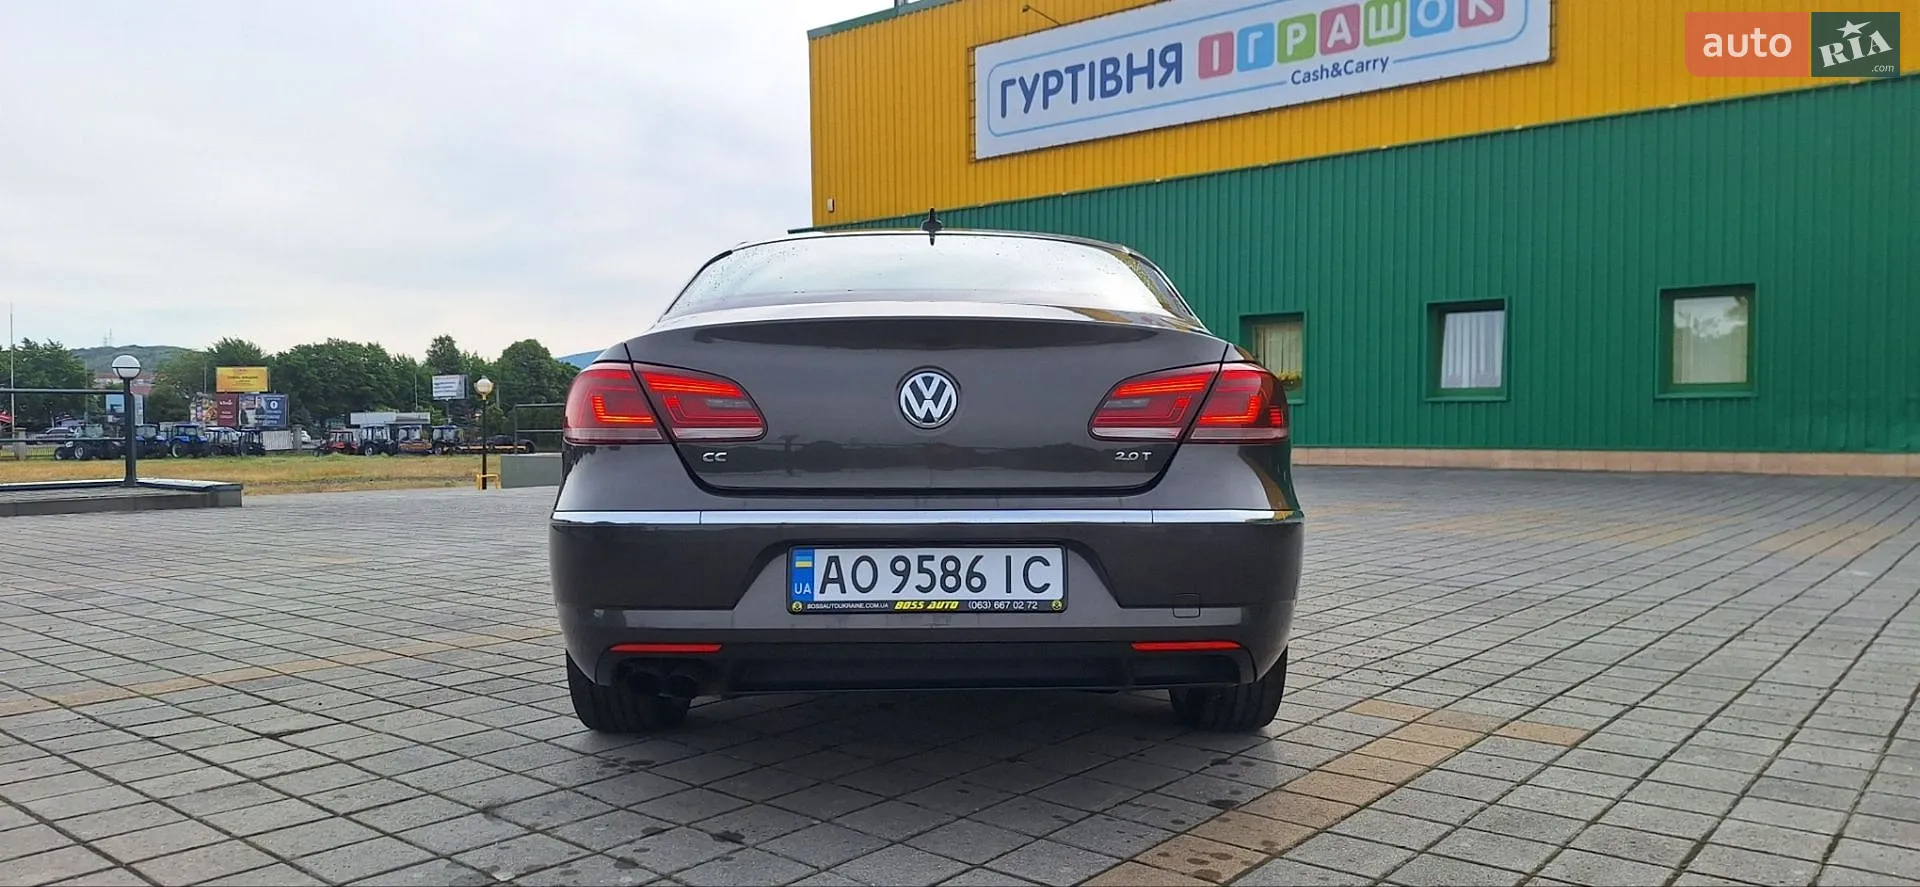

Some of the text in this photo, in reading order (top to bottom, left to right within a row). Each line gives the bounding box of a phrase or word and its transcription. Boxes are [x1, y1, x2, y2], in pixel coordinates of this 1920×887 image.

[1290, 55, 1391, 87] Cash&Carry
[999, 42, 1183, 119] ГУРТІВНЯ
[702, 452, 728, 462] CC
[819, 554, 1052, 595] AO 9586 IC
[794, 582, 812, 595] UA
[893, 600, 959, 610] BOSS AUTO
[968, 600, 1038, 610] (063) 667 02 72
